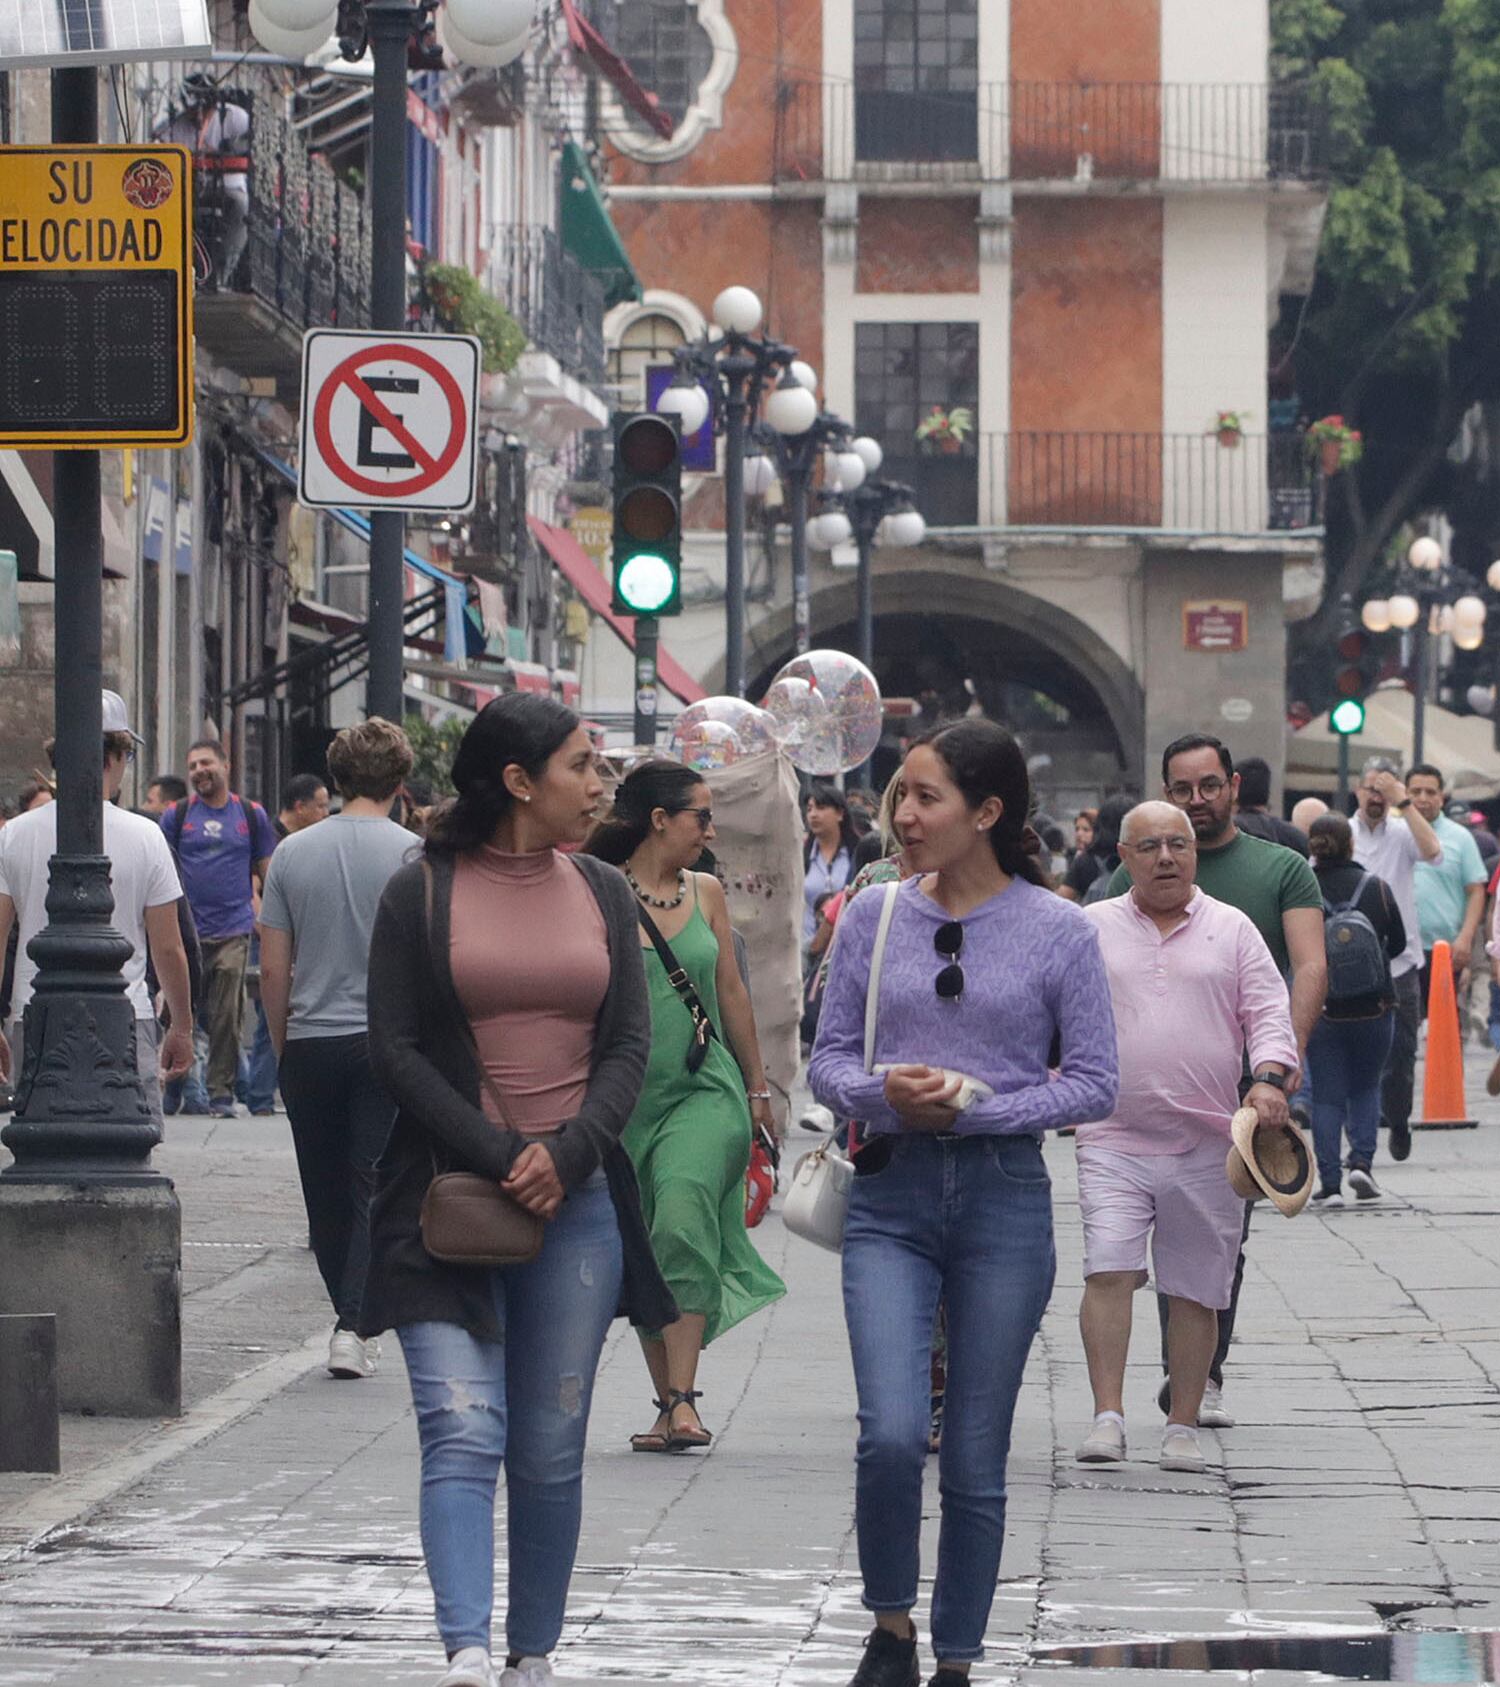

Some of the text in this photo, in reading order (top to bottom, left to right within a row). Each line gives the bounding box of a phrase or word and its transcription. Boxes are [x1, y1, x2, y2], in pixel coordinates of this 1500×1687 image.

[48, 160, 93, 204] SU
[2, 218, 163, 263] ELOCIDAD
[357, 376, 420, 468] E
